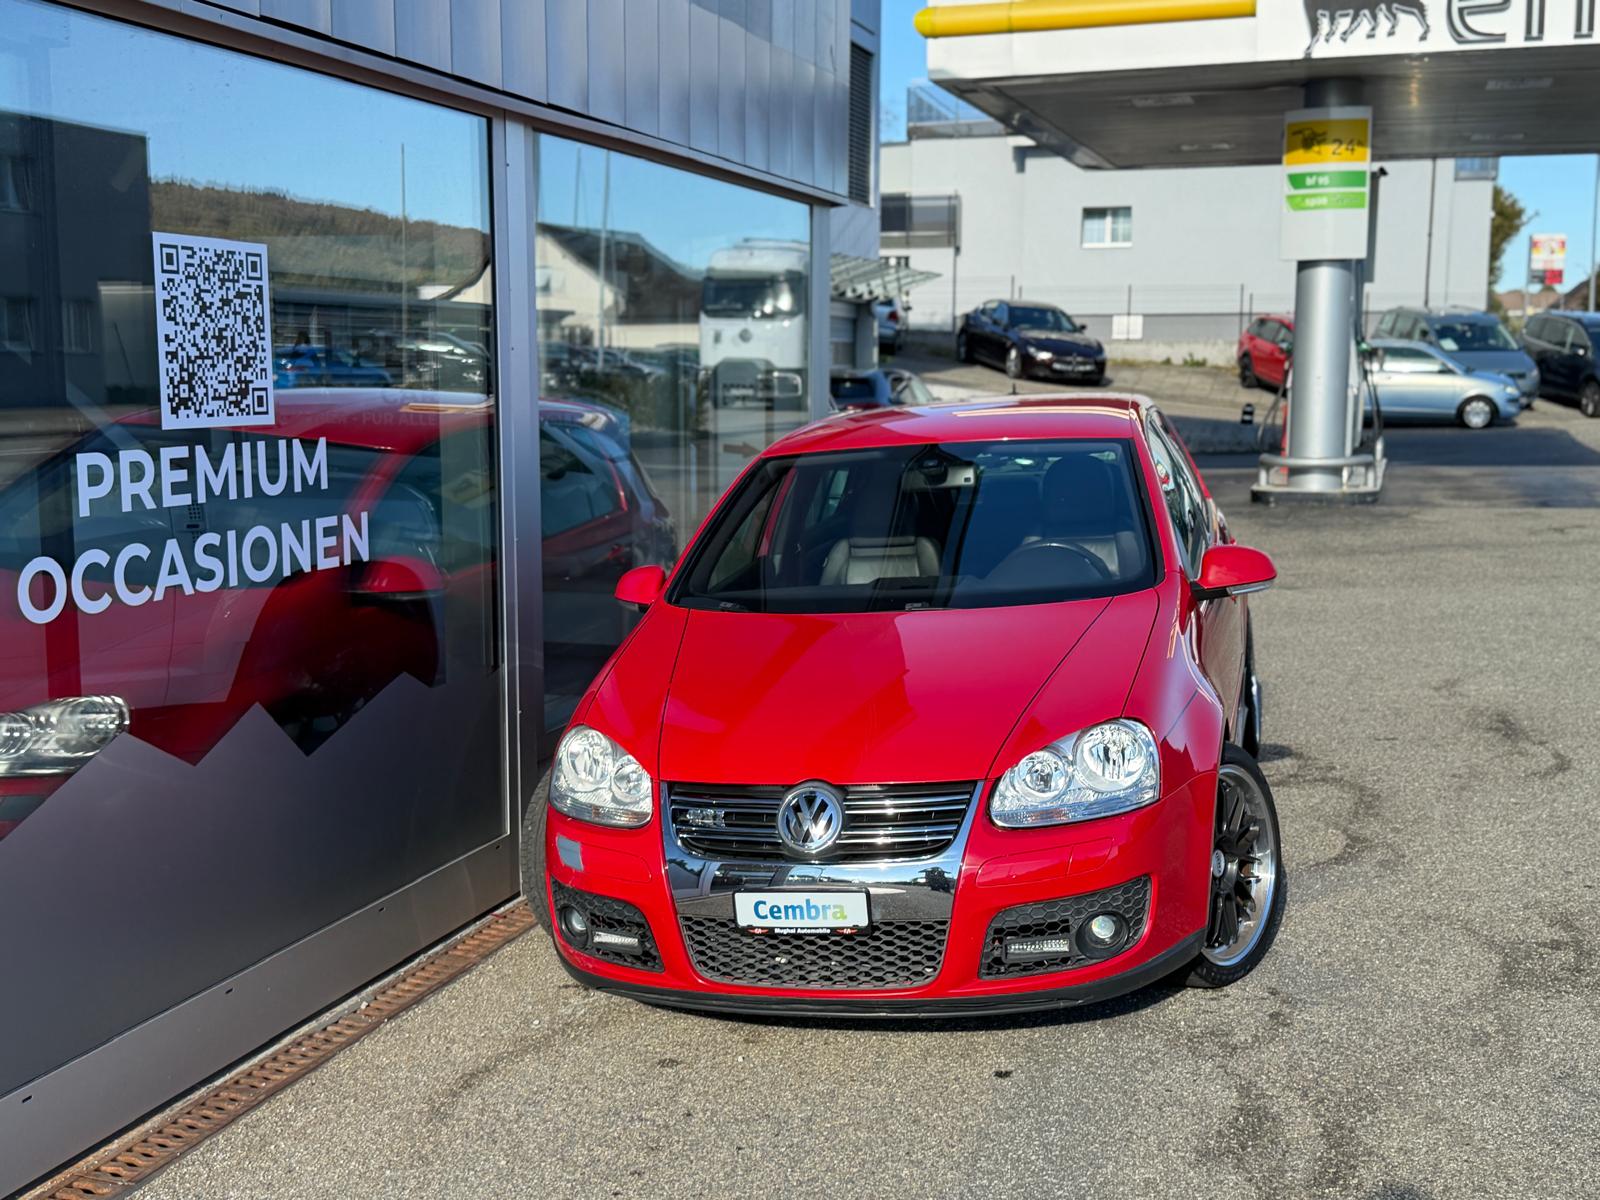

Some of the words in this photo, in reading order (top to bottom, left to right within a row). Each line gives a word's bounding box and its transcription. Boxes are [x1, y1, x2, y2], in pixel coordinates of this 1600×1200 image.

[76, 437, 329, 518] PREMIUM
[17, 511, 370, 624] OCCASIONEN
[753, 898, 847, 920] Cembra
